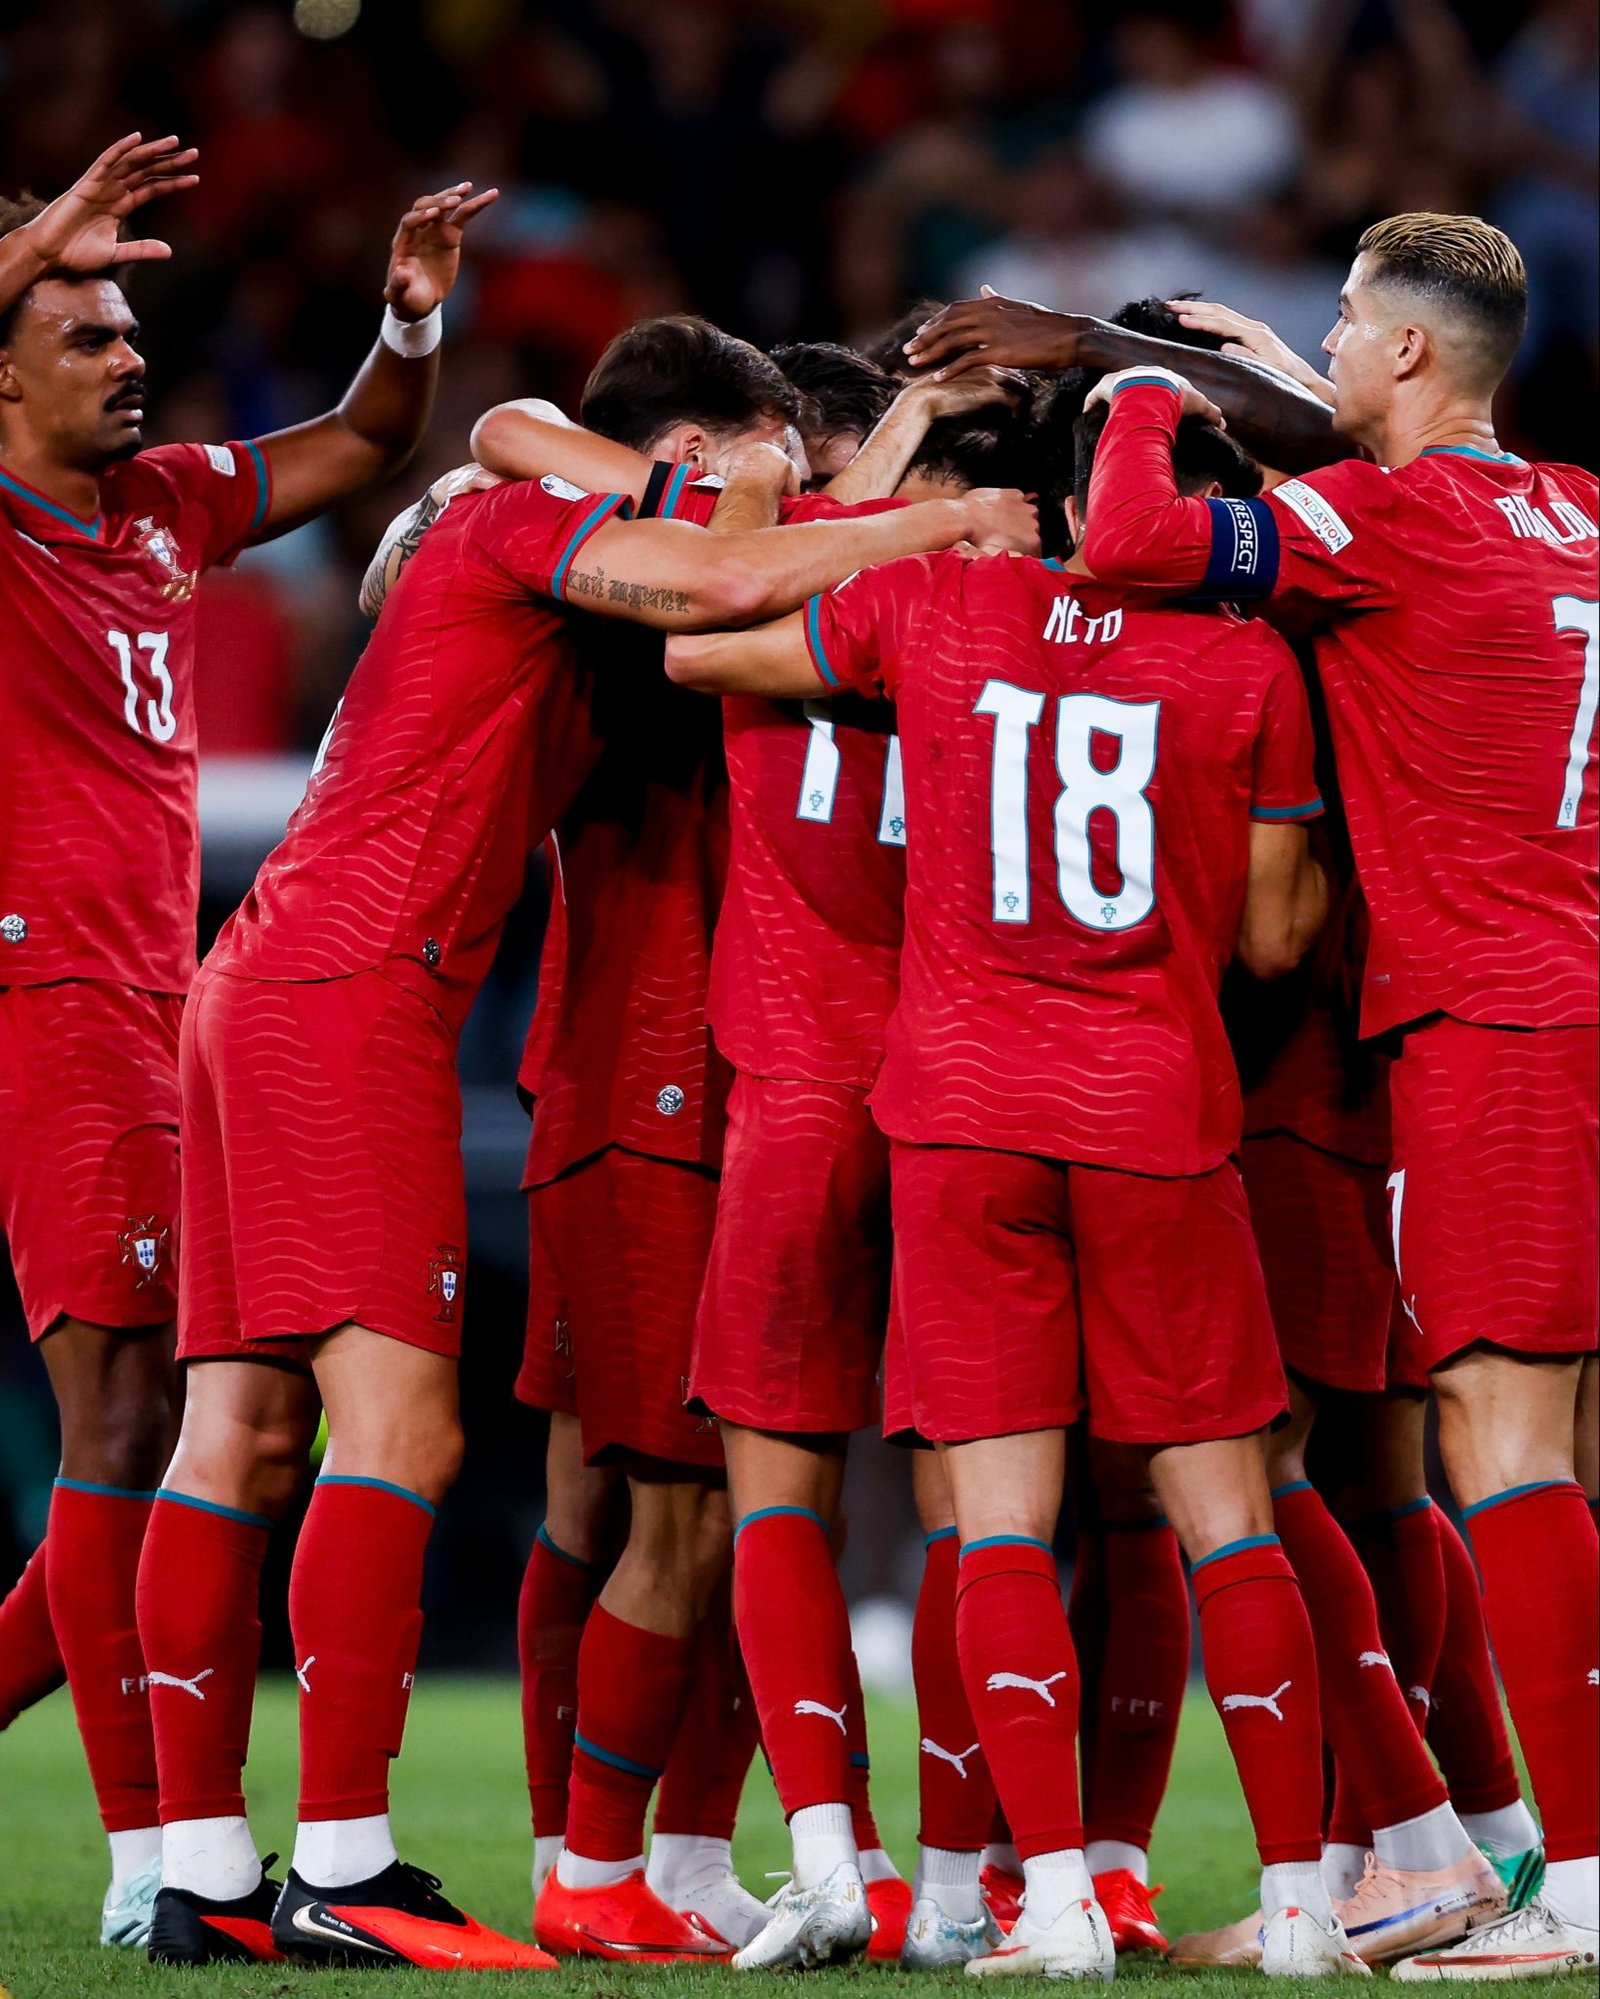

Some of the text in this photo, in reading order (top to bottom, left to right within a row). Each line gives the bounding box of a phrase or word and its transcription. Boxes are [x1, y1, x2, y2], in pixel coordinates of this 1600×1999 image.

[1232, 502, 1254, 574] RESPECT
[1283, 484, 1344, 548] FOUNDATION
[1043, 595, 1123, 645] NETO
[107, 630, 177, 743] 13
[1551, 594, 1599, 828] 7
[972, 679, 1161, 932] 18
